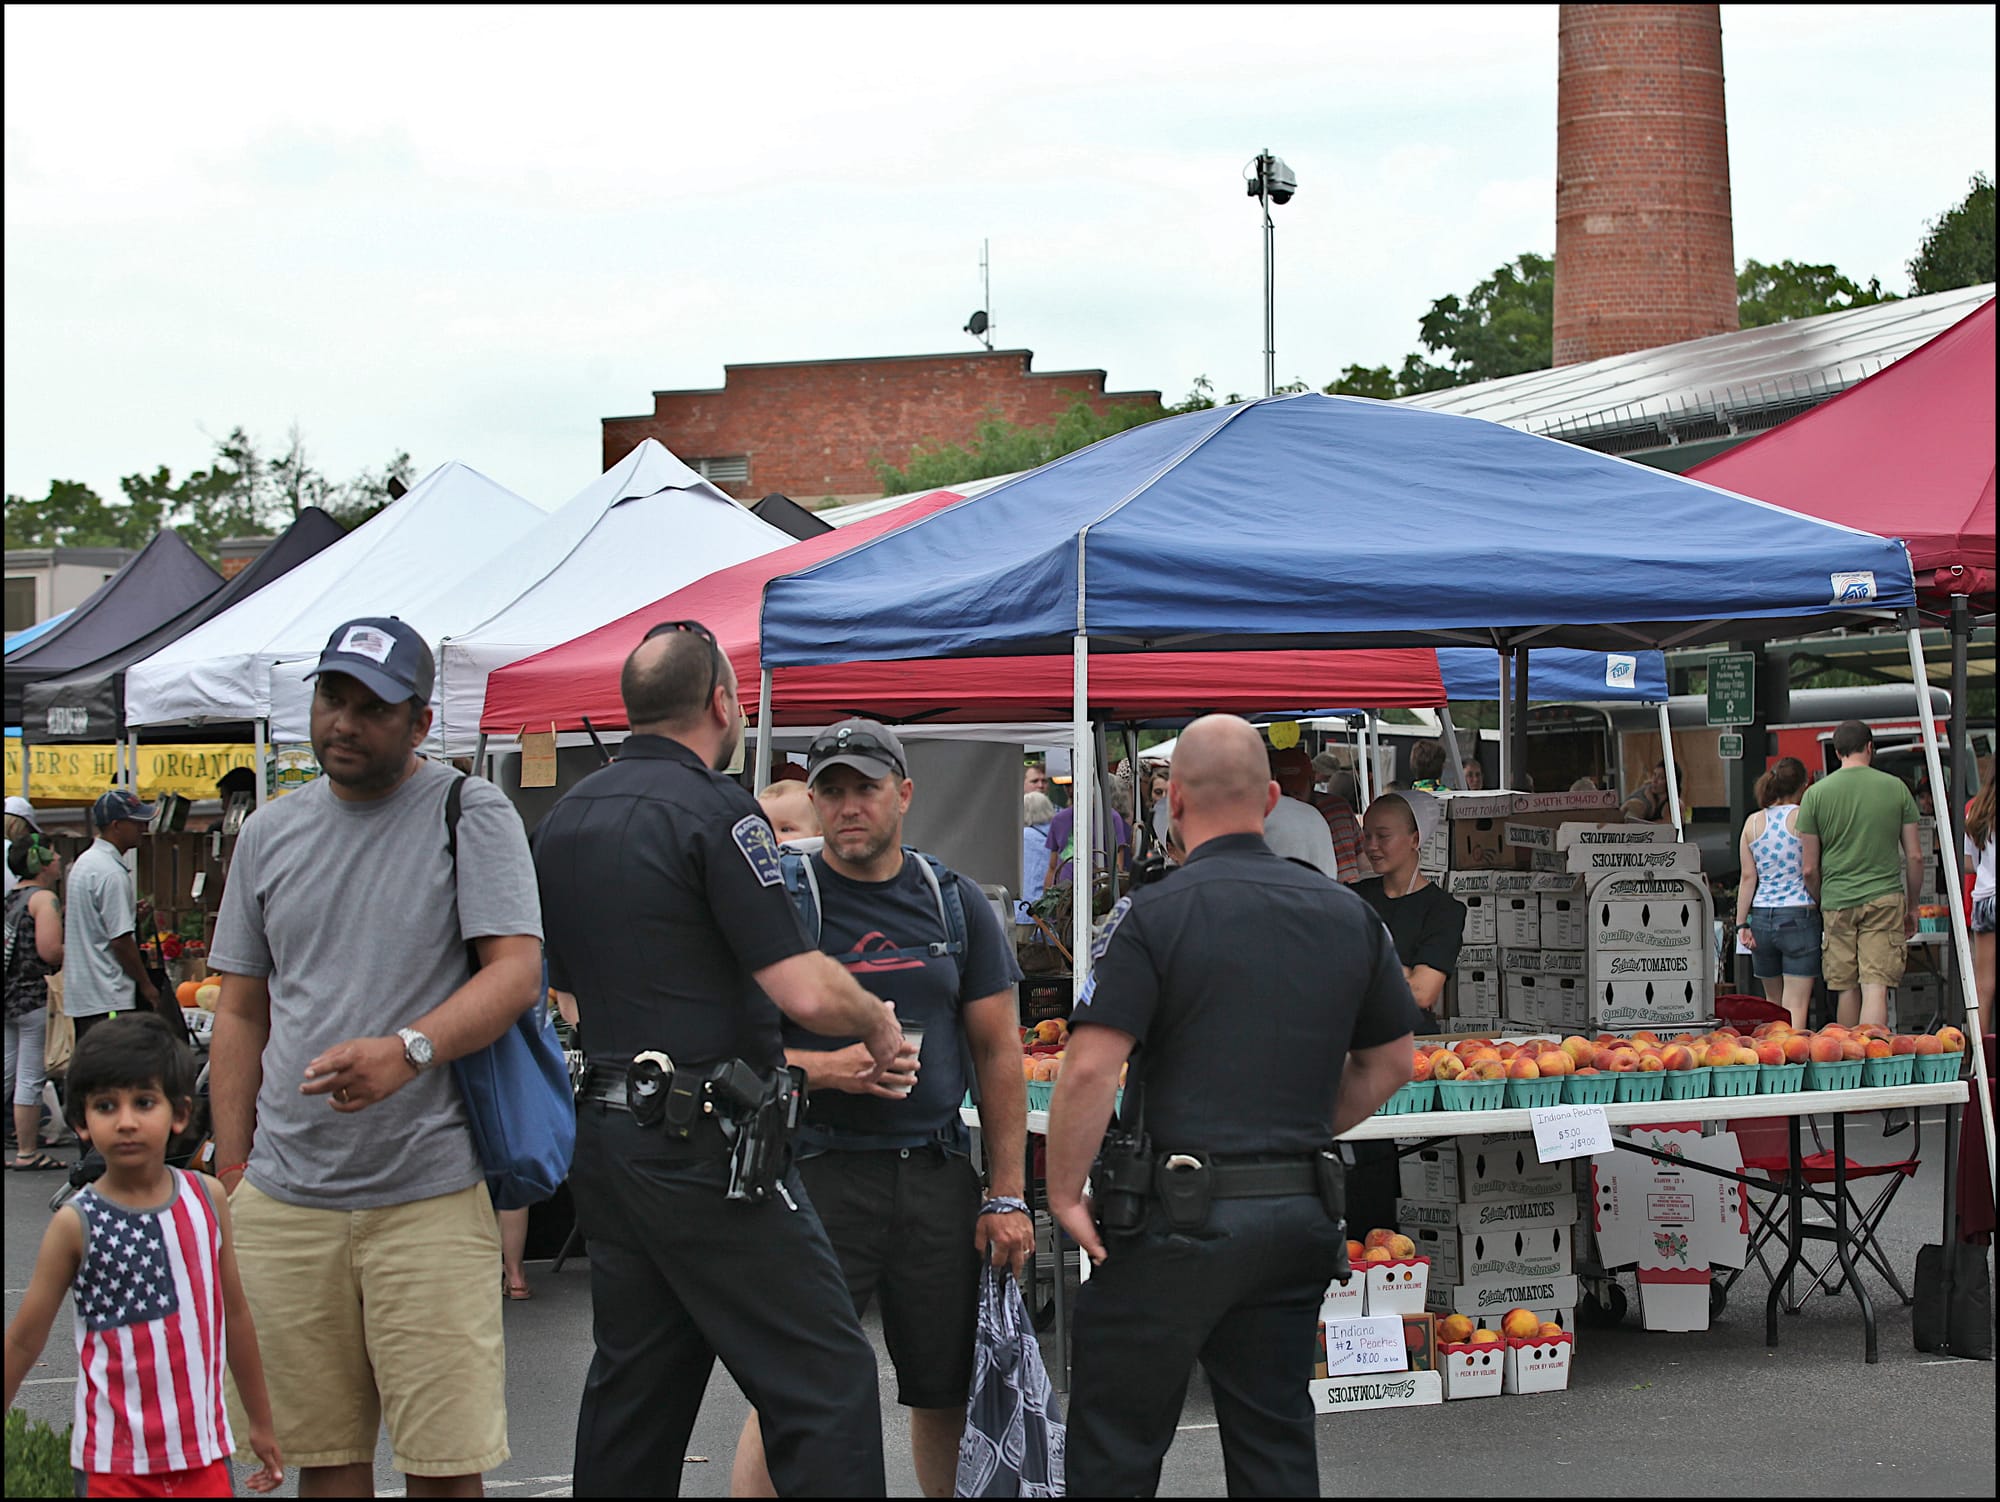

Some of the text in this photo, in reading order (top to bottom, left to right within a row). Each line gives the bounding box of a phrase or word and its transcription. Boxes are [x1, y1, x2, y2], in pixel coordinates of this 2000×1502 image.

[7, 751, 80, 775] NER'S
[1532, 793, 1598, 807] SMITH TOMATO
[1455, 805, 1478, 816] SMITH
[1592, 853, 1645, 867] TOMATOES
[1637, 880, 1685, 893] TOMATOES
[1599, 929, 1691, 947] Quality & Freshness
[1611, 957, 1688, 974] Selected TOMATOES
[1602, 1006, 1694, 1022] Quality & Freshness
[1536, 1107, 1603, 1125] Indiana Peaches
[1558, 1127, 1581, 1140] $5.00
[1472, 1180, 1562, 1195] Quality & Freshness
[1418, 1207, 1450, 1224] TOMATOES
[1480, 1202, 1554, 1225] Selected TOMATOES
[1471, 1260, 1560, 1276] Quality & Freshness
[1478, 1284, 1554, 1307] Selected TOMATOES
[1330, 1324, 1375, 1339] Indiana
[1336, 1337, 1398, 1350] #2 Peaches
[1356, 1352, 1380, 1364] $8.00
[1328, 1379, 1416, 1404] Selected TOMATOES
